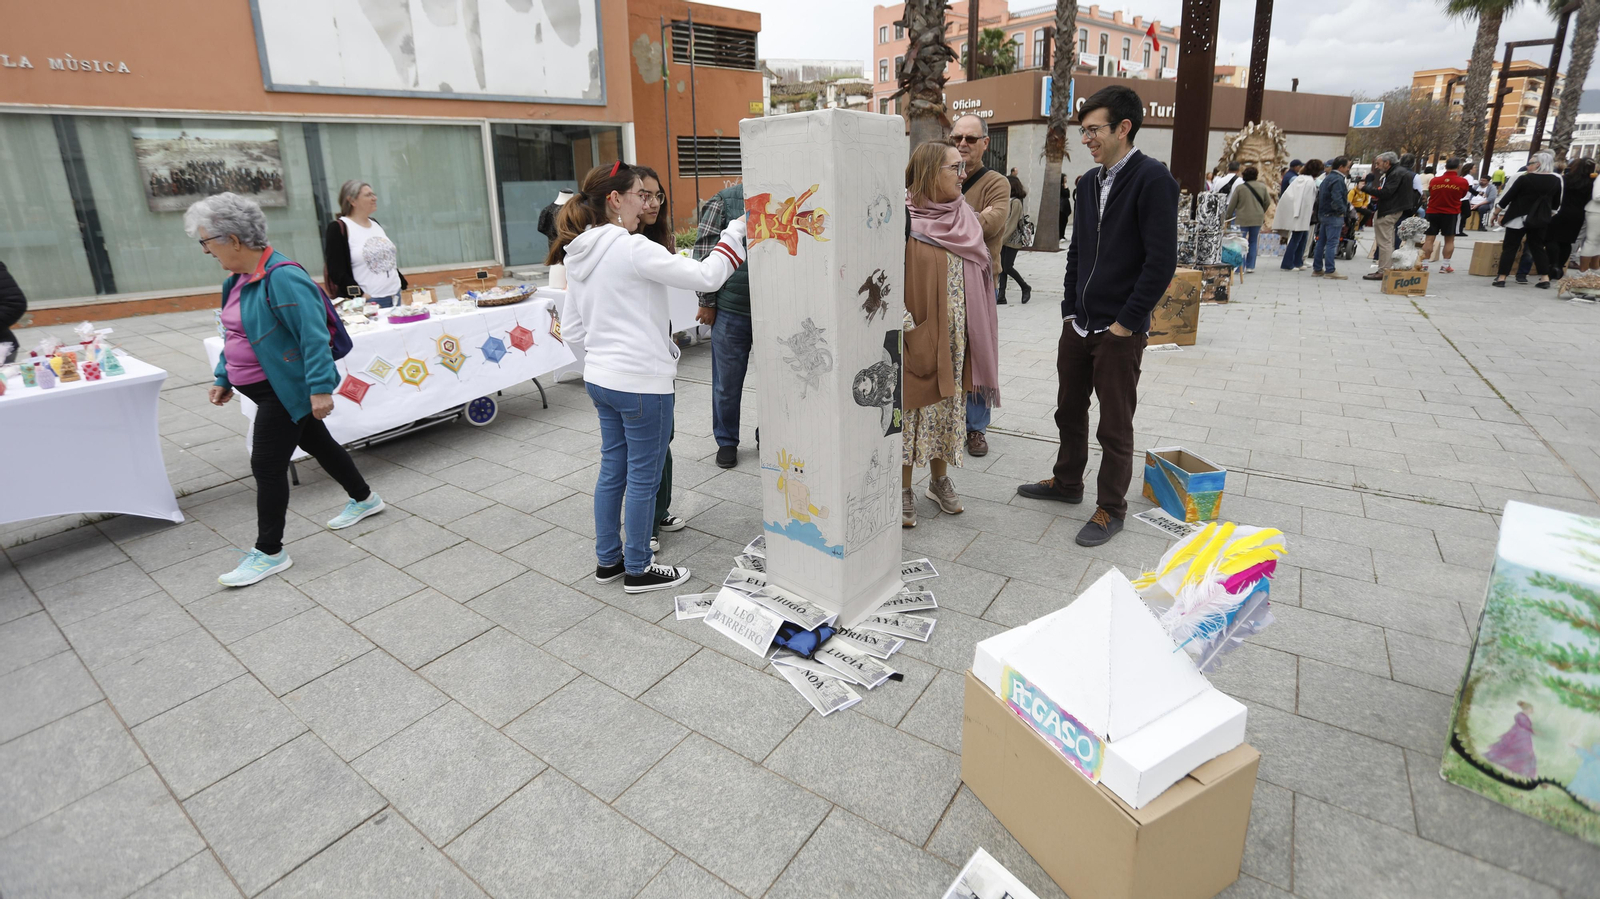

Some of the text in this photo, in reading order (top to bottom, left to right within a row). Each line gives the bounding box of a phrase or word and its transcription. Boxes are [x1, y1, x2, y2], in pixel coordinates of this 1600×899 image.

[0, 54, 34, 69] LA
[952, 98, 981, 110] Oficina
[1149, 102, 1176, 118] Turi
[960, 109, 994, 119] Tismo
[1394, 276, 1421, 290] Flota
[773, 595, 807, 614] HUGO
[881, 596, 924, 607] STINA
[733, 606, 755, 624] LEO
[712, 609, 763, 646] BARREIRO
[801, 669, 824, 690] NOA
[1011, 677, 1095, 763] PEGASO
